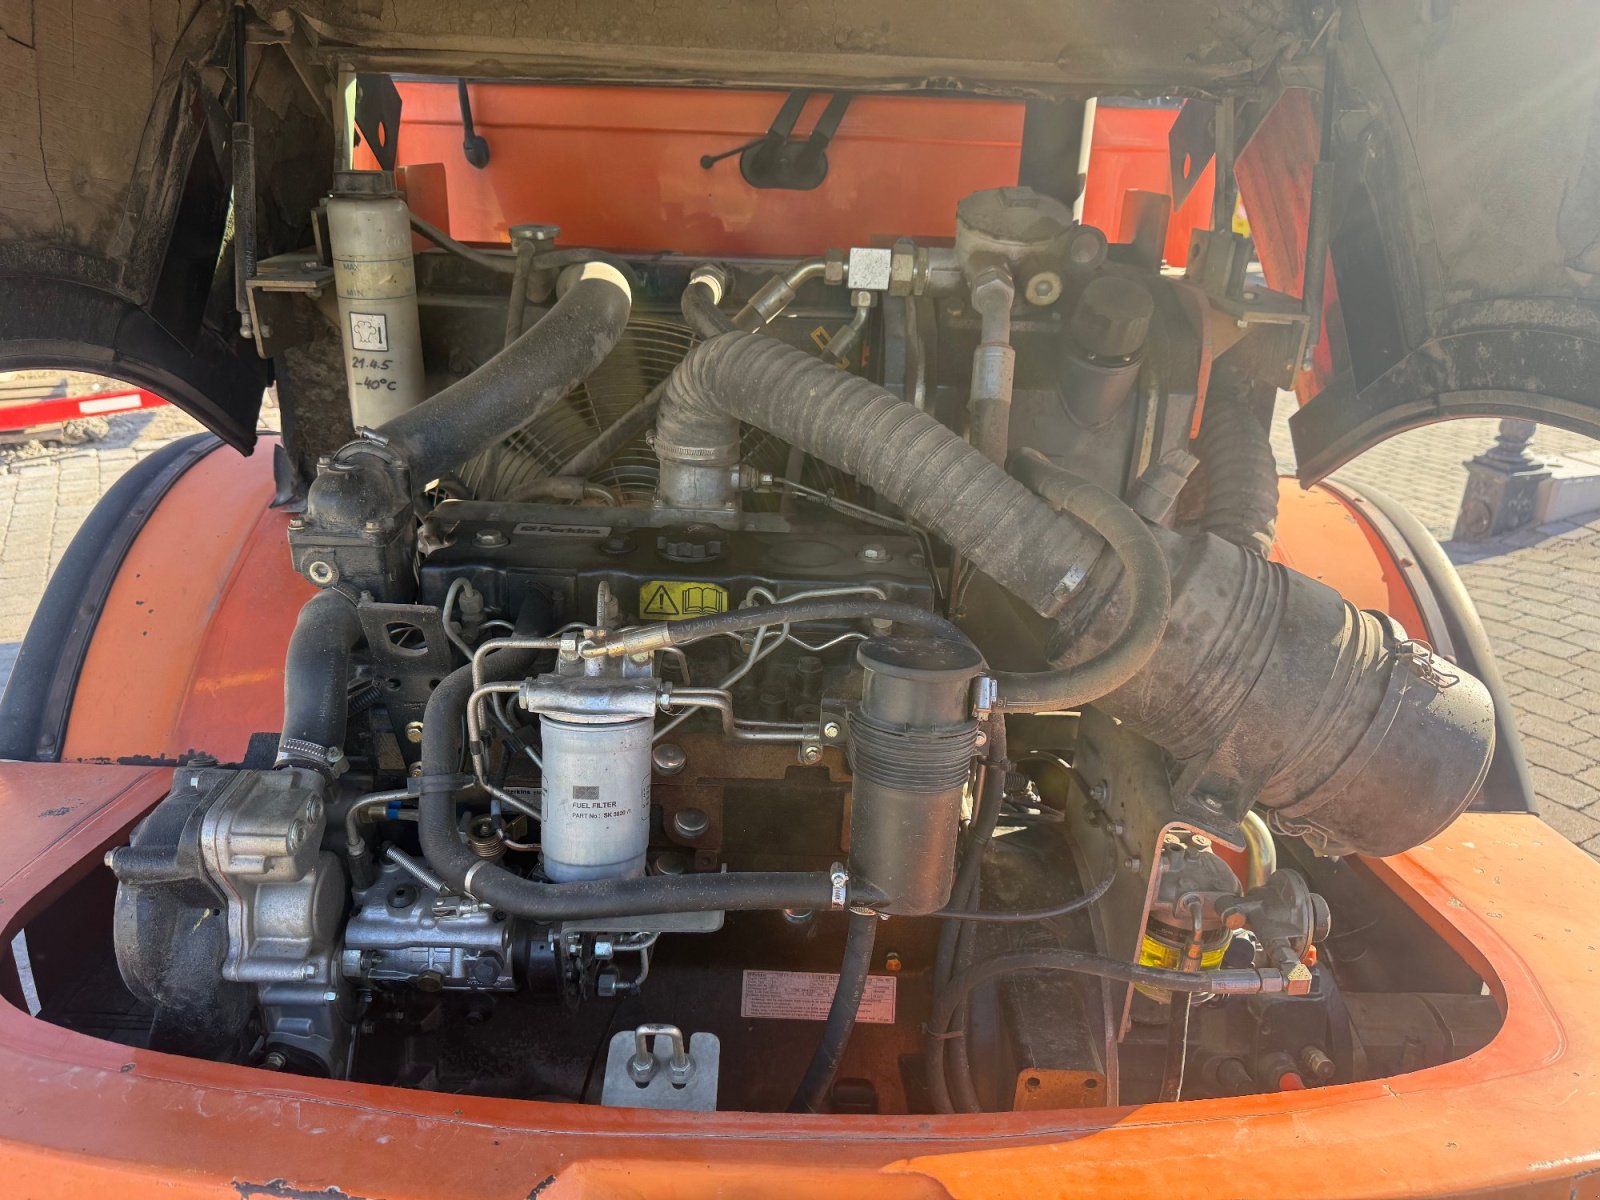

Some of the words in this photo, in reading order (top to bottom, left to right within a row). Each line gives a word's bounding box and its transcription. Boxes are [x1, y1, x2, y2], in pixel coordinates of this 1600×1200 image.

[343, 263, 359, 272] MAX
[346, 288, 365, 297] MIN
[537, 525, 602, 535] Perkins
[592, 801, 617, 809] FILTER
